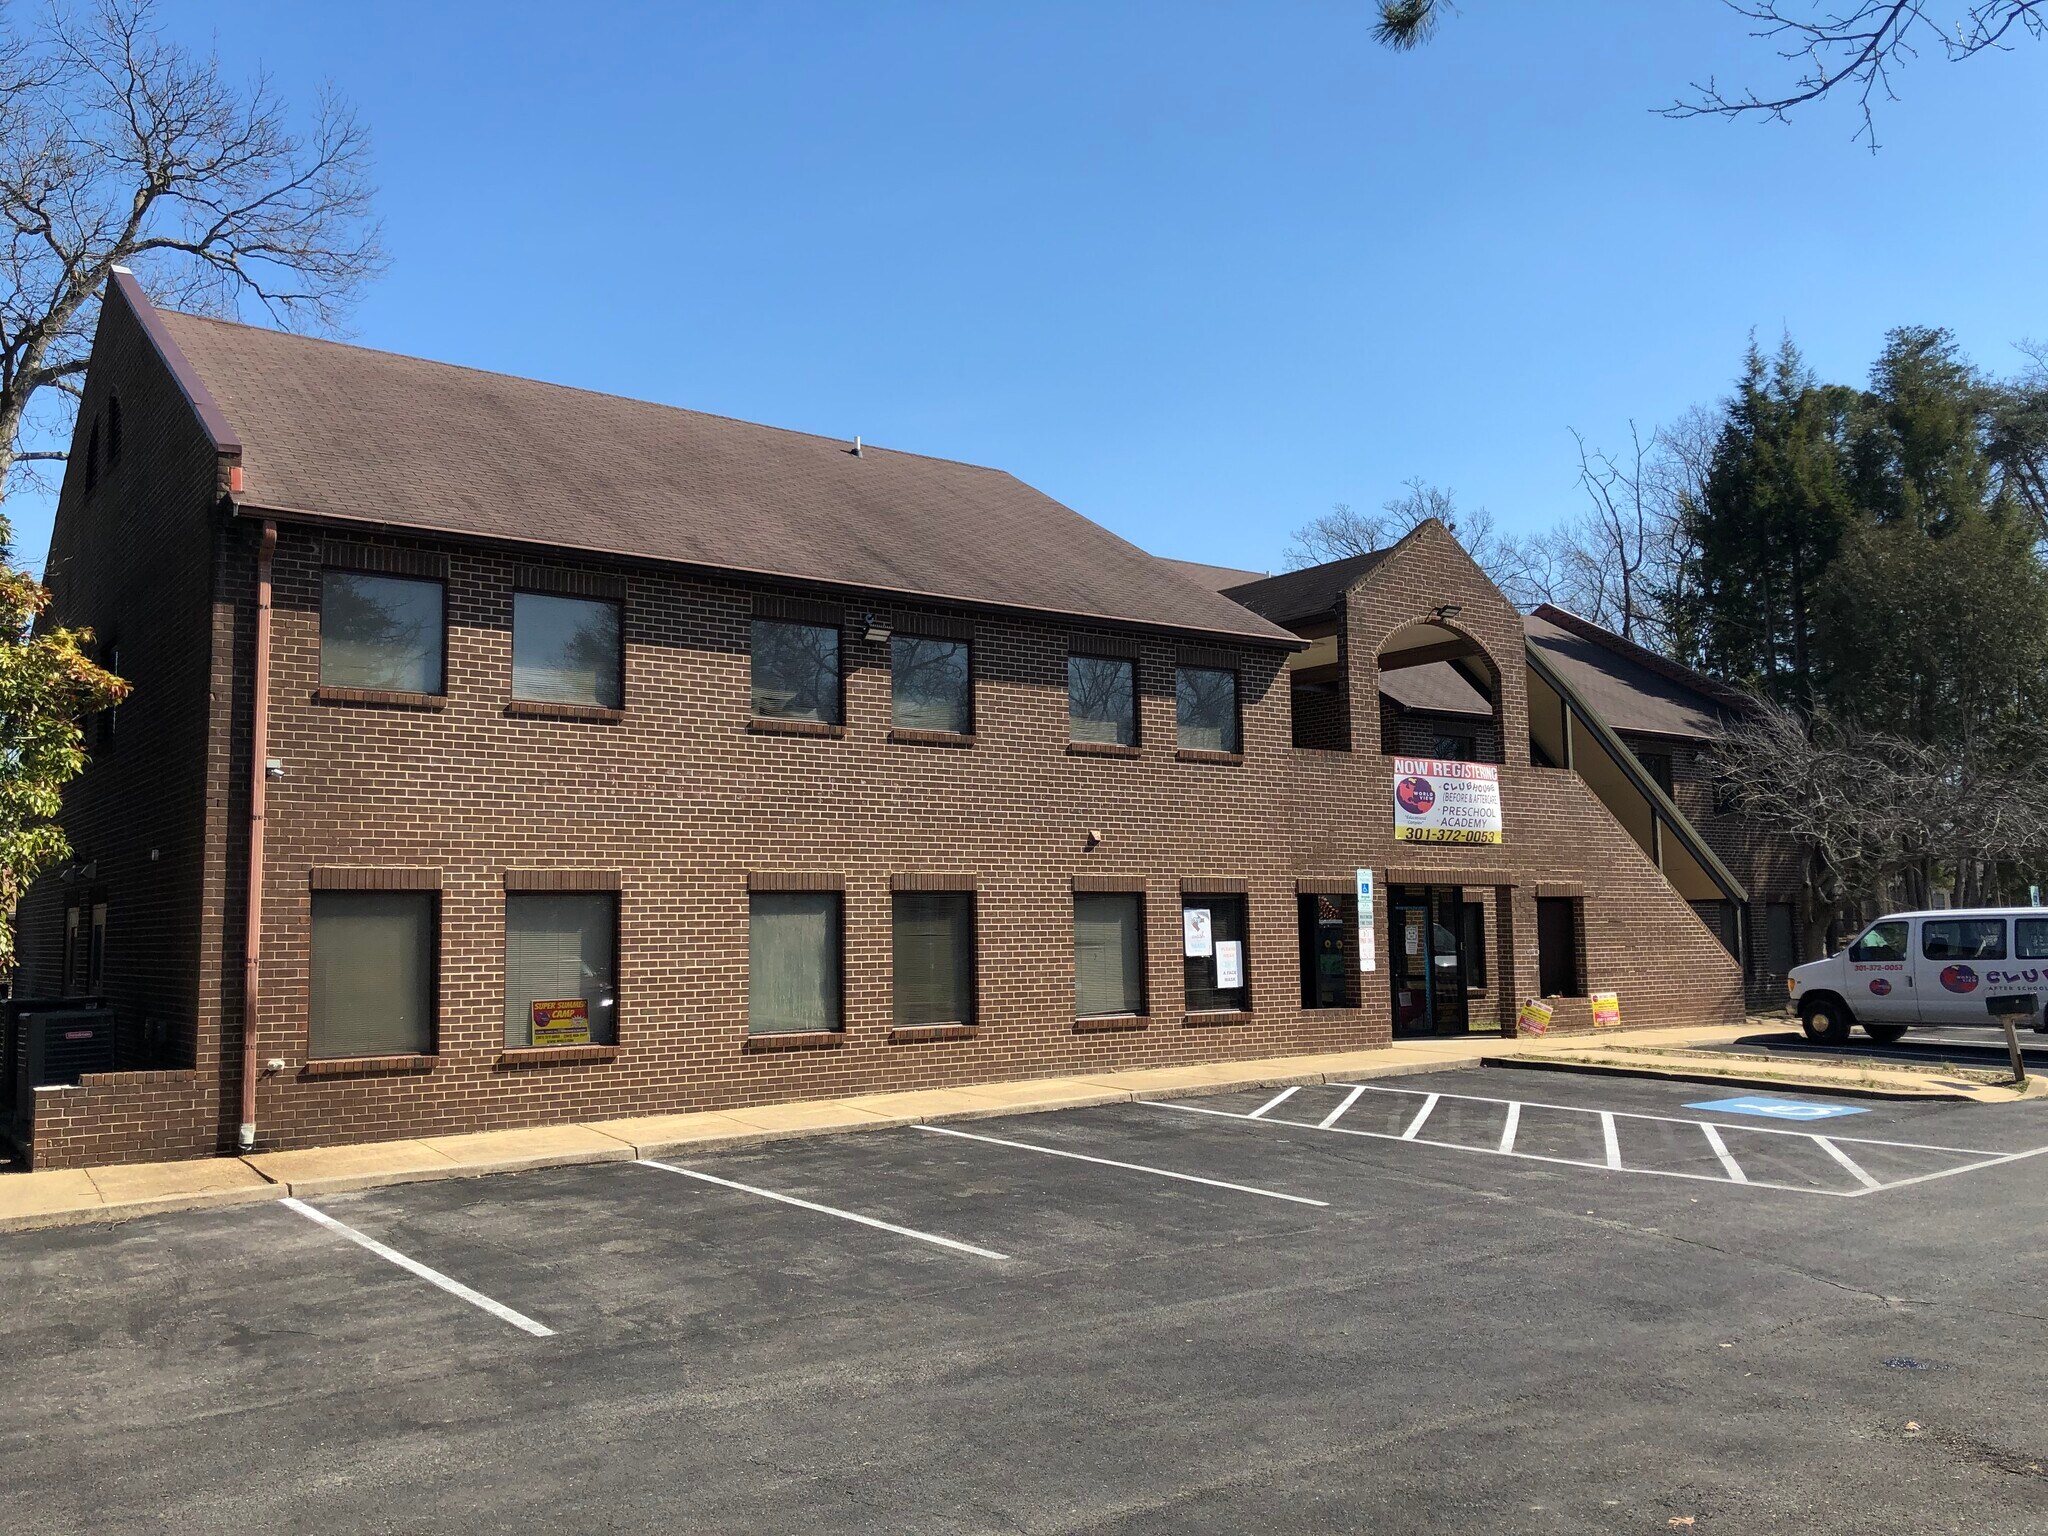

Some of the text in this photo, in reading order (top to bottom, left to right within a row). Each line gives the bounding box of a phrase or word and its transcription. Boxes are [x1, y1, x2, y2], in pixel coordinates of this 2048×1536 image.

[1395, 759, 1498, 780] NOW REGISTERING
[1443, 782, 1495, 793] CLUBHOUSE
[1468, 795, 1473, 804] &
[1442, 806, 1496, 818] PRESCHOOL
[1440, 817, 1488, 828] ACADEMY
[1405, 827, 1495, 843] 301-372-0053
[1855, 964, 1904, 972] 301-372-0053
[534, 1002, 556, 1010] SUPER
[552, 1009, 576, 1018] CAMP
